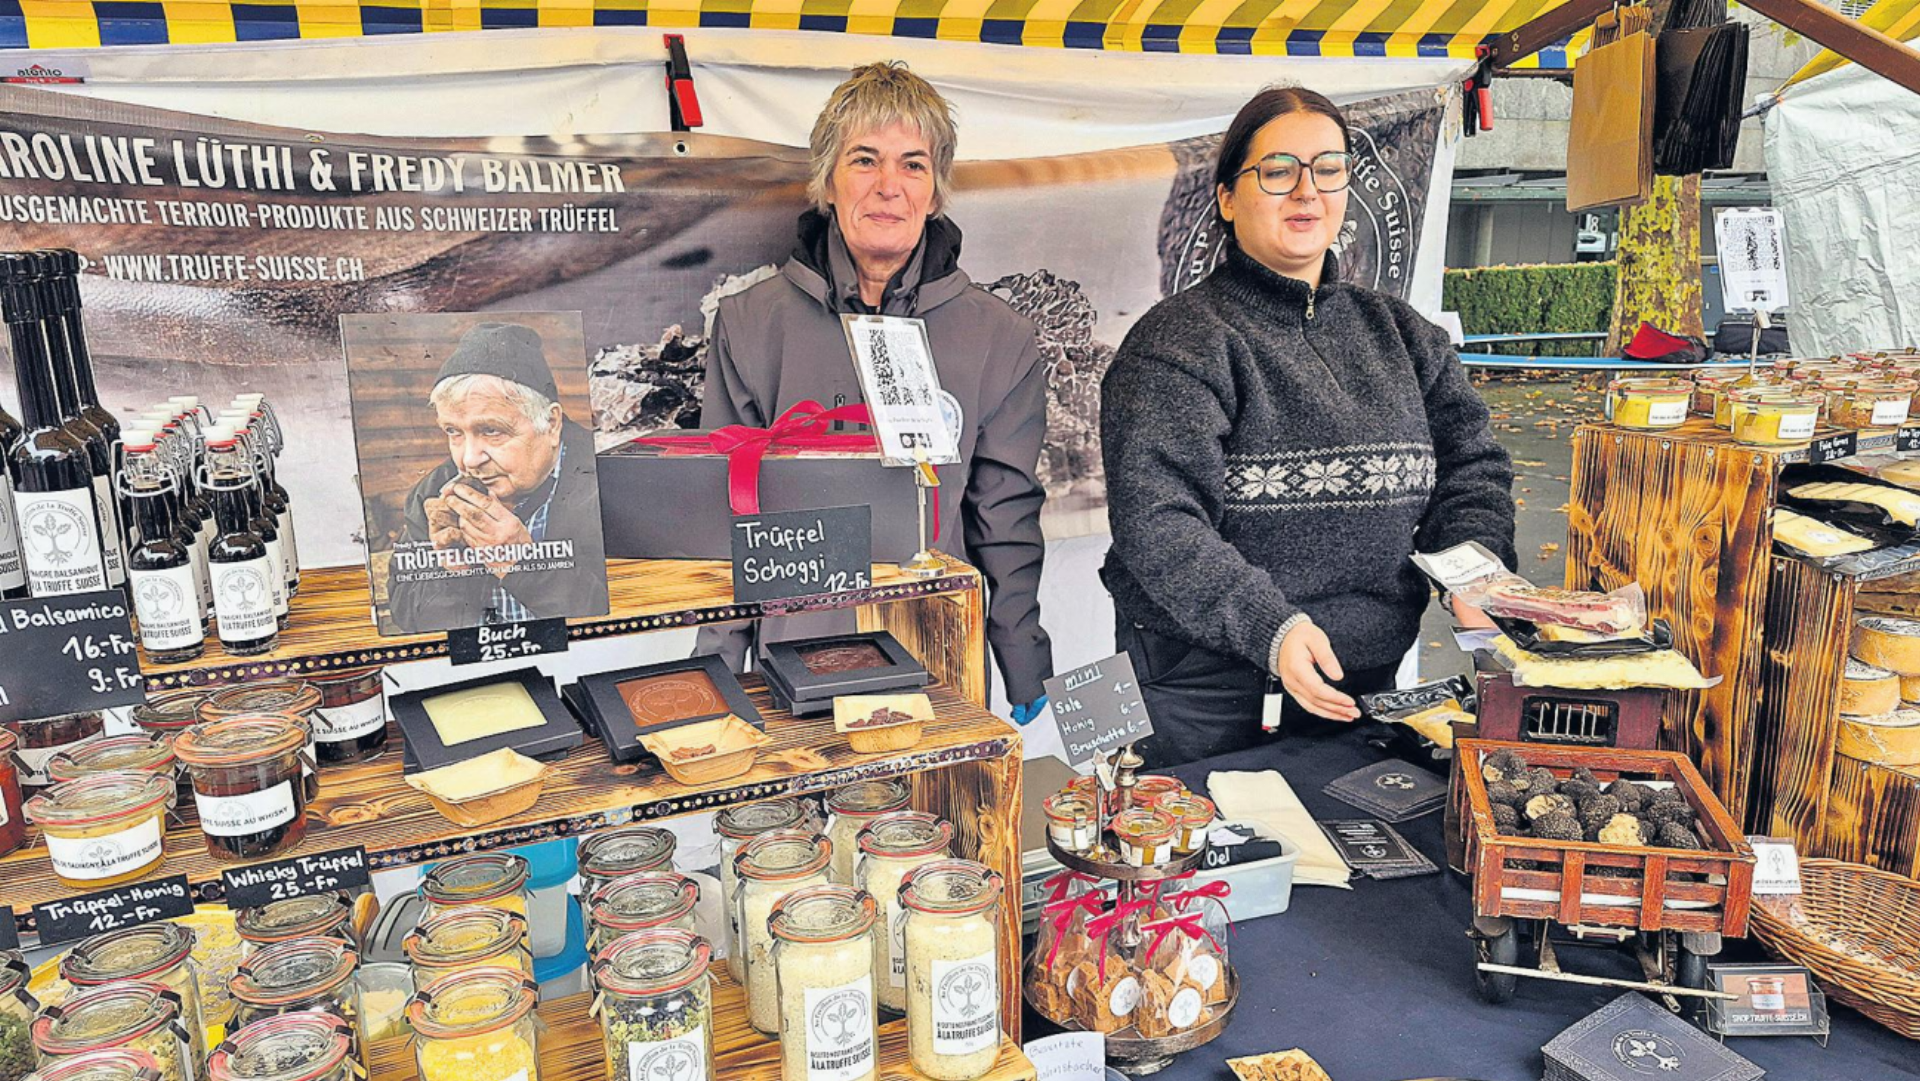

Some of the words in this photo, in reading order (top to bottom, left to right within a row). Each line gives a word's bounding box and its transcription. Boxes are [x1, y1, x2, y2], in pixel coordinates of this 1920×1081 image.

[171, 137, 295, 191] LÜTHI
[310, 148, 337, 191] &
[349, 152, 467, 193] FREDY
[481, 158, 626, 194] BALMER
[155, 200, 369, 231] TERROIR-PRODUKTE
[376, 206, 415, 231] AUS
[421, 206, 533, 233] SCHWEIZER
[538, 203, 620, 233] TRÜFFEL
[1377, 191, 1406, 279] Suisse
[103, 254, 365, 283] WWW.TRUFFE-SUISSE.CH
[736, 519, 825, 552] Trüffel
[394, 540, 573, 571] TRÜFFELGESCHICHTEN
[743, 553, 825, 584] Schoggi
[10, 602, 125, 630] Balsamico
[478, 624, 527, 644] Buch
[1064, 663, 1103, 691] mini
[1061, 717, 1096, 735] Honig
[243, 816, 257, 826] AU
[258, 806, 289, 821] WHISKY
[226, 866, 298, 889] Whisky
[296, 851, 364, 875] Trüffel
[942, 1030, 951, 1040] LA
[951, 1028, 976, 1040] TRUFFE
[816, 1060, 825, 1070] LA
[826, 1056, 852, 1070] TRUFFE
